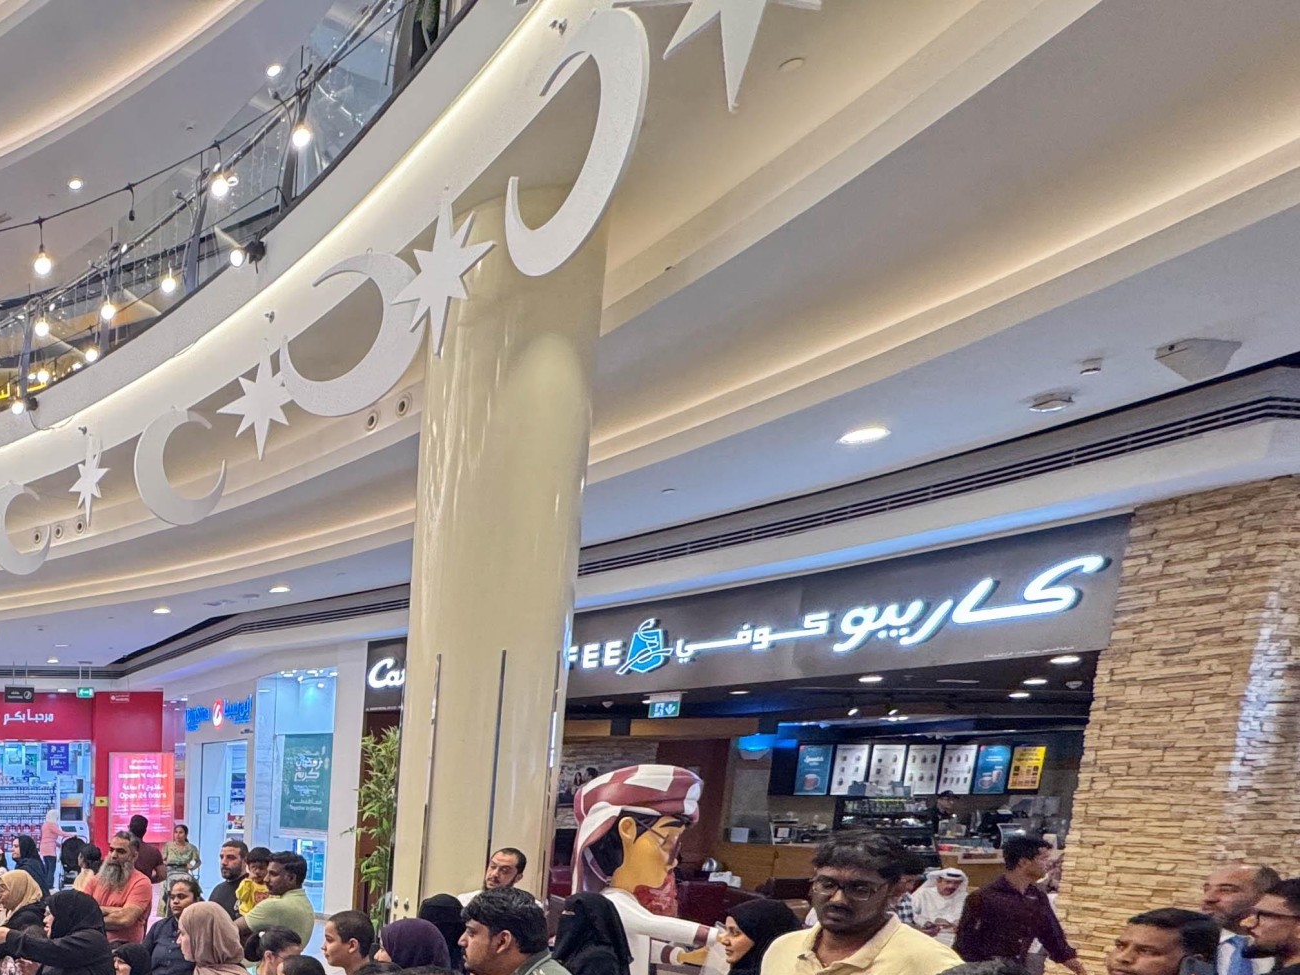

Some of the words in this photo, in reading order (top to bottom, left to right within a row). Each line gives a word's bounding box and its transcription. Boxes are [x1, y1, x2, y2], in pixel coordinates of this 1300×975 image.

[833, 554, 1104, 652] كاريبو
[676, 611, 830, 664] كوفي
[2, 711, 26, 726] بكم
[119, 792, 138, 800] Open
